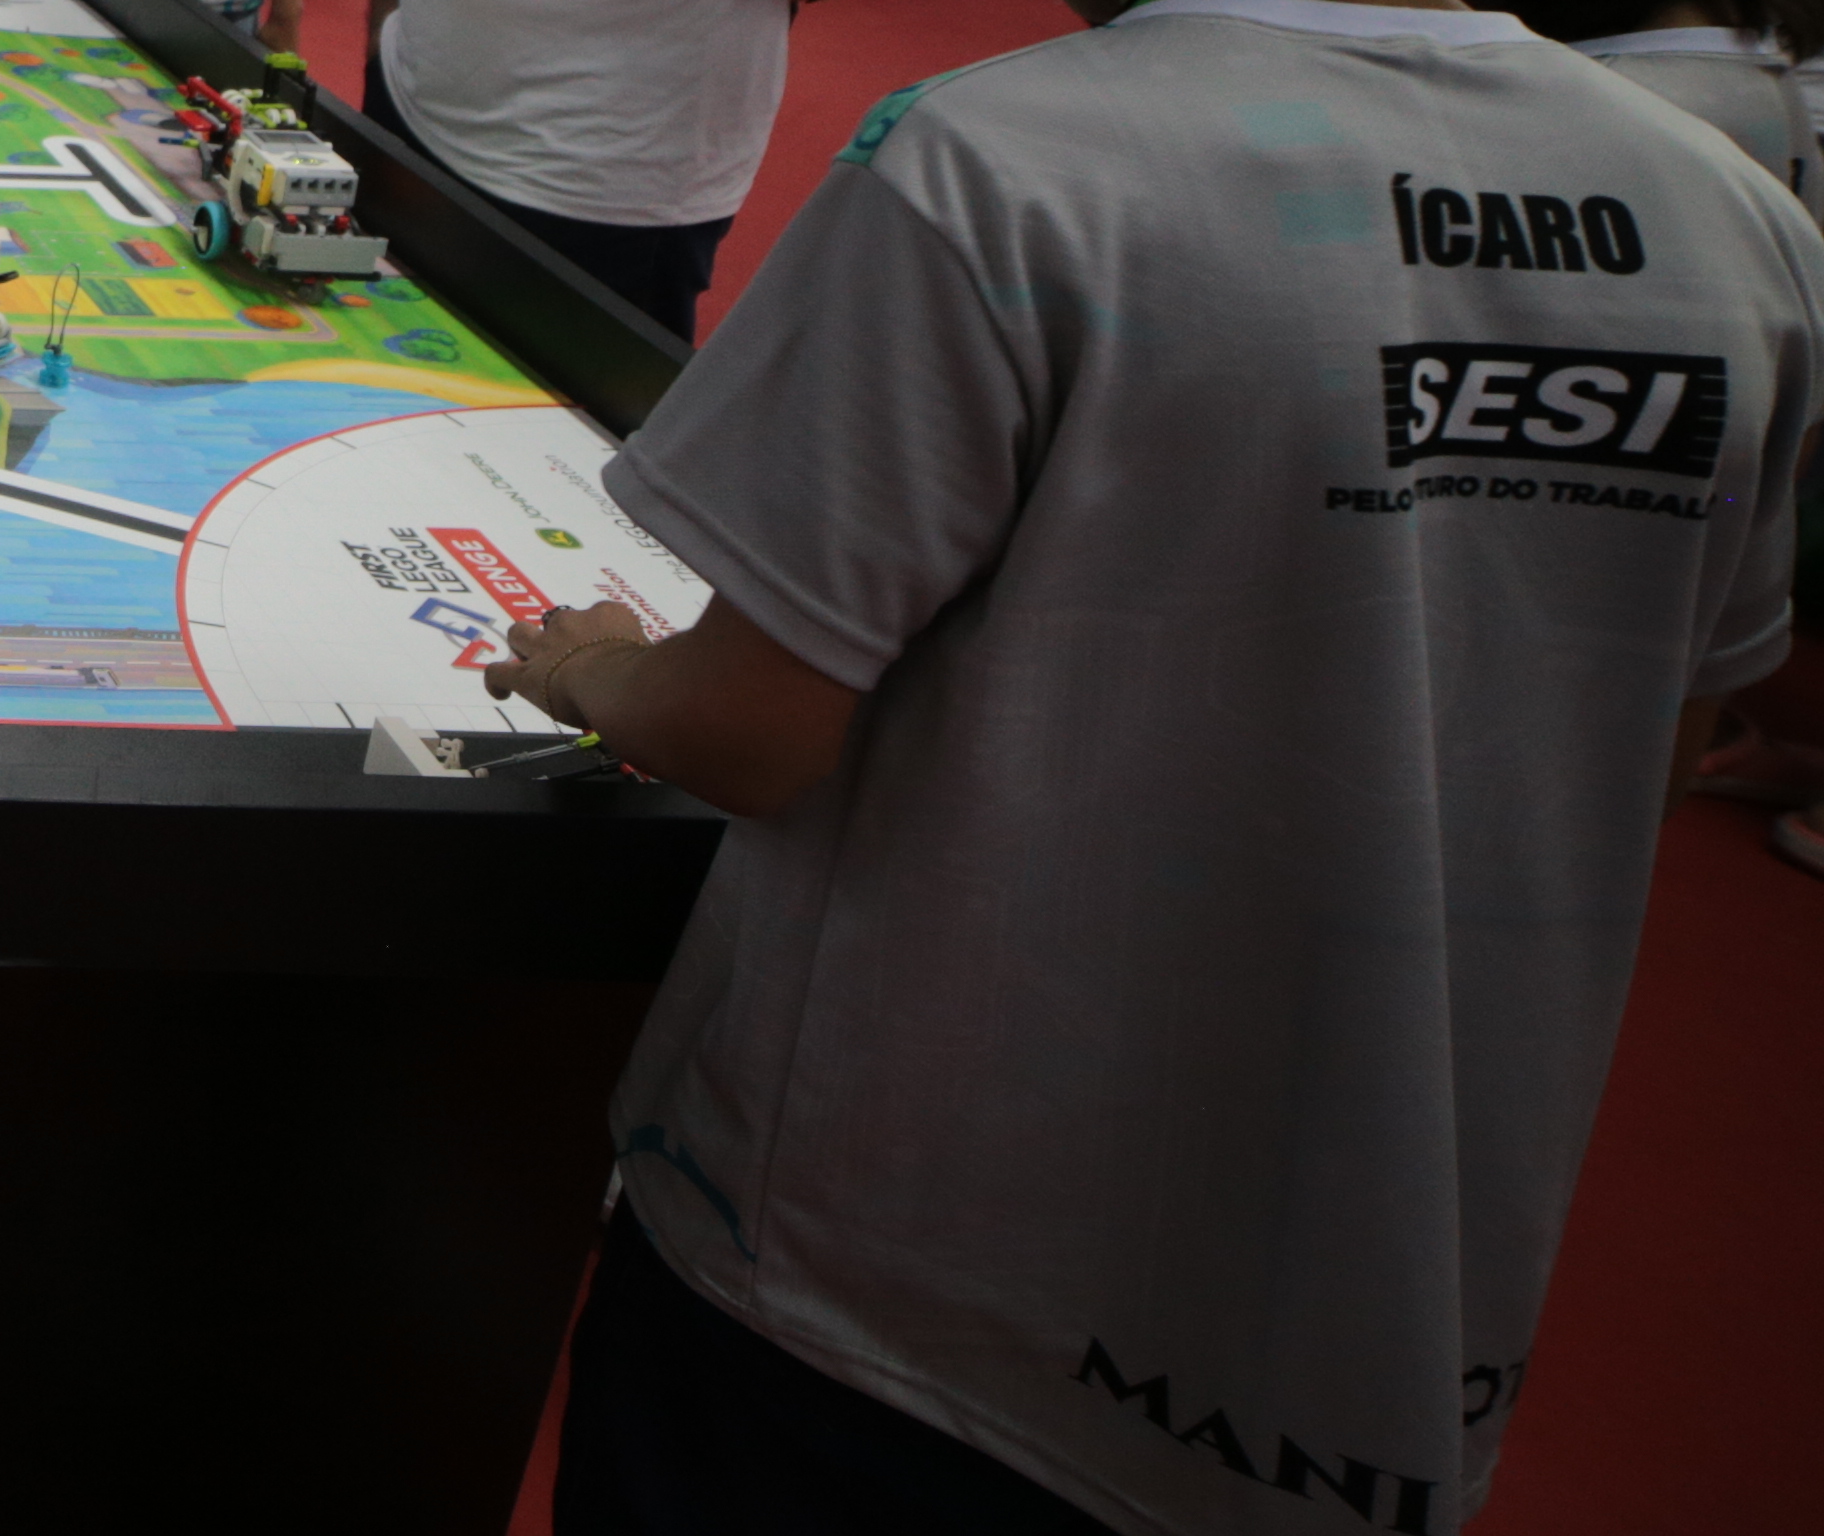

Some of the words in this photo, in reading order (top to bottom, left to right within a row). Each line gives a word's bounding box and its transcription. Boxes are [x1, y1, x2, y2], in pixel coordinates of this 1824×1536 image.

[1391, 172, 1647, 276] ÍCARO
[1407, 356, 1689, 454] SESI
[463, 451, 513, 495] DEERE
[1487, 477, 1539, 502] DO
[505, 489, 550, 524] JOHN
[339, 539, 411, 592] FIRST
[380, 546, 441, 593] LEGO
[388, 526, 472, 594] LEAGUE
